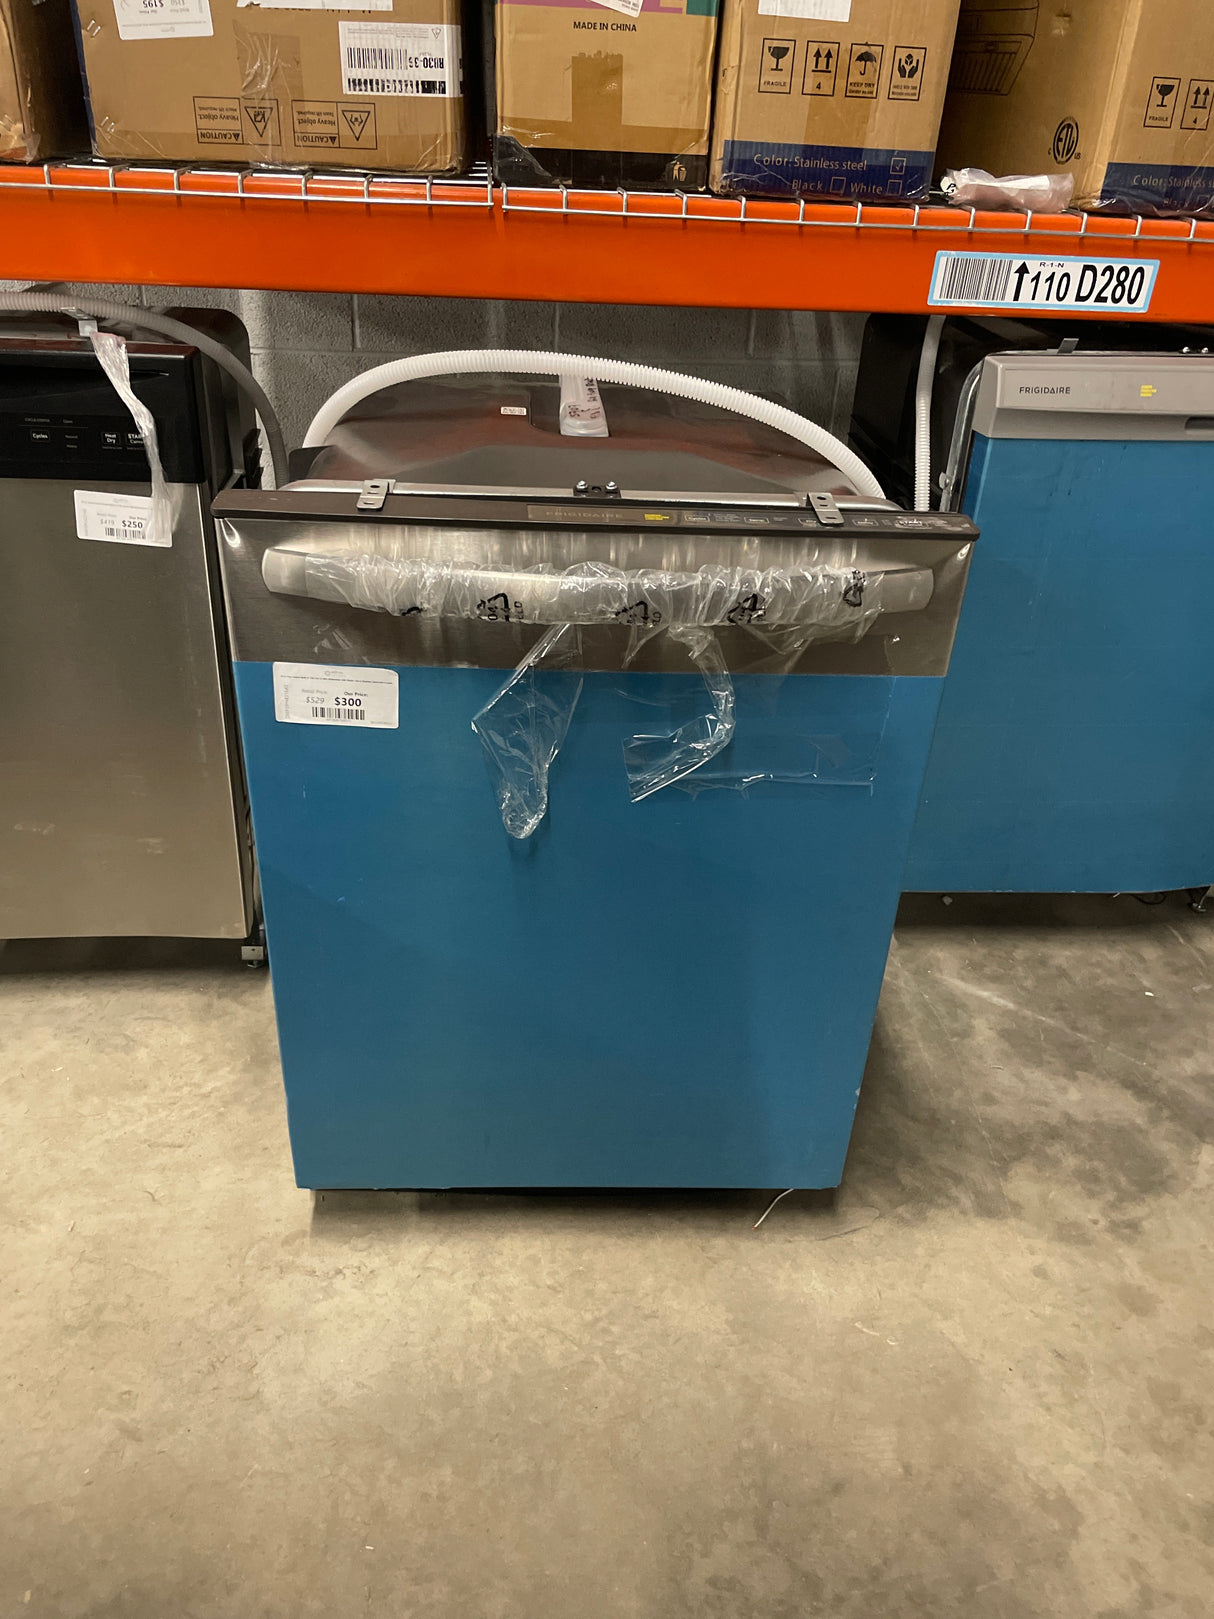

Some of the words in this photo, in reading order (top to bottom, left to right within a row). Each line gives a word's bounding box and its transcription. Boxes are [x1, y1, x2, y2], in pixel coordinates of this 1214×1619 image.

[573, 21, 597, 30] MADE
[599, 22, 609, 31] IN
[610, 22, 637, 32] CHINA
[763, 80, 787, 88] FRAGILE
[815, 81, 822, 91] 4
[219, 113, 239, 122] Heavy
[317, 117, 336, 127] Heavy
[1192, 116, 1198, 125] 4
[200, 131, 233, 139] CAUTION
[297, 135, 329, 143] CAUTION
[793, 155, 839, 171] Stainless
[841, 158, 867, 171] steel
[791, 179, 824, 191] Black
[850, 181, 884, 195] White
[1038, 261, 1066, 269] R-1-N
[1030, 271, 1071, 302] 110
[1074, 263, 1146, 306] D280
[1018, 386, 1072, 395] FRIGIDAIRE
[545, 510, 624, 519] FRIGIDAIRE
[121, 519, 144, 530] $250
[305, 696, 326, 704] $529
[334, 696, 362, 707] $300
